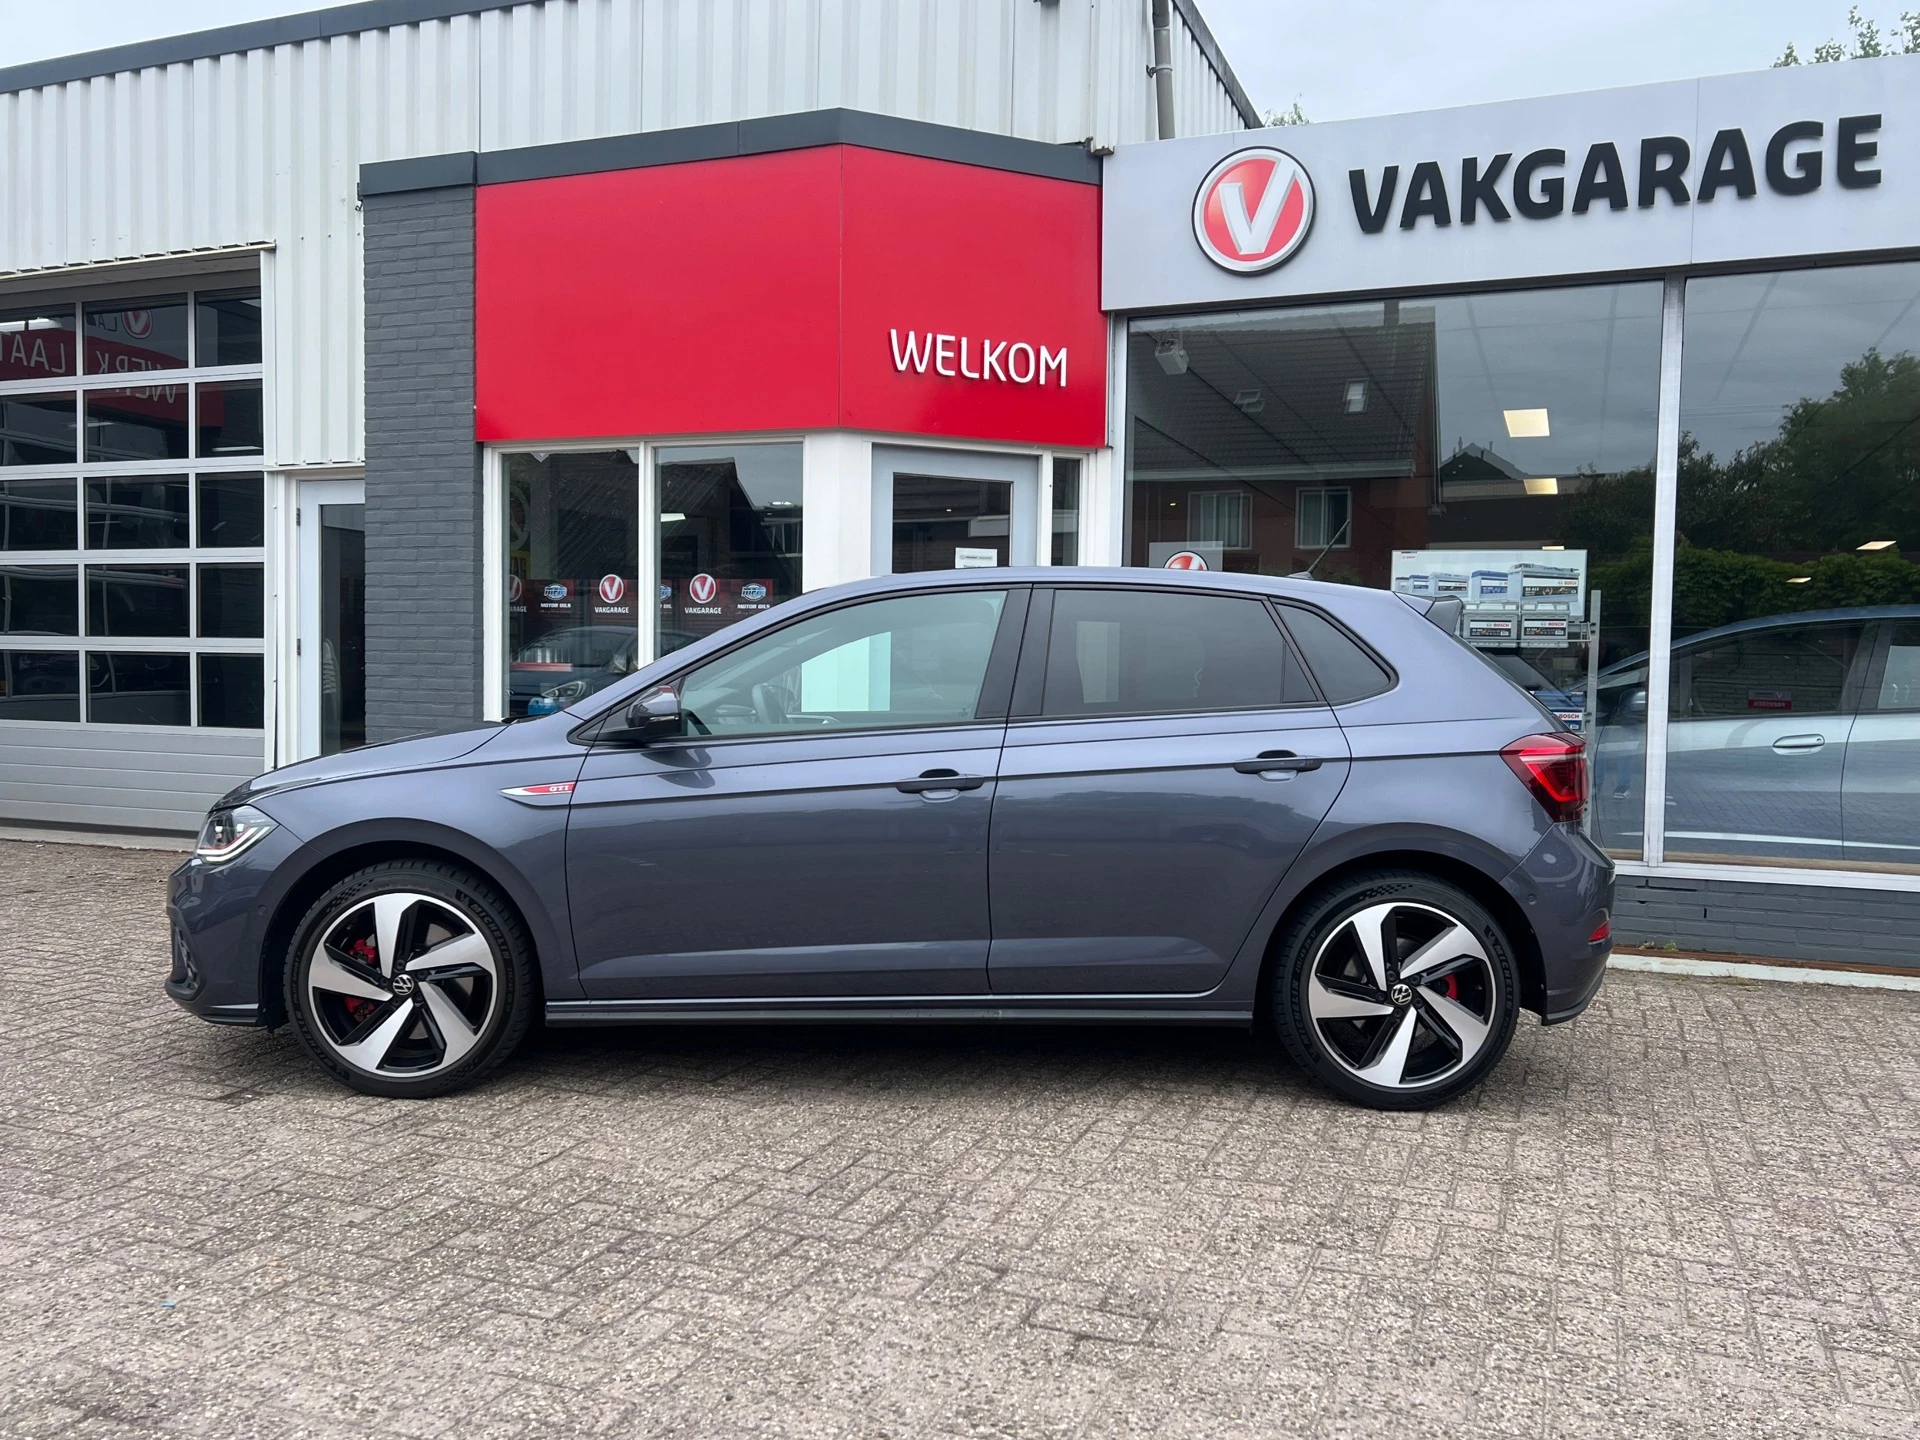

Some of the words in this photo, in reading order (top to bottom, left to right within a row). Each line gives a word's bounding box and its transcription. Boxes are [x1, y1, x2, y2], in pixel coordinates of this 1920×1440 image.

[1349, 114, 1882, 234] VAKGARAGE
[890, 328, 1067, 387] WELKOM
[471, 903, 511, 960] MICHELIN
[1494, 945, 1512, 1010] MICHELIN
[295, 1011, 335, 1068] MICHELIN
[1291, 980, 1311, 1045] MICHELIN
